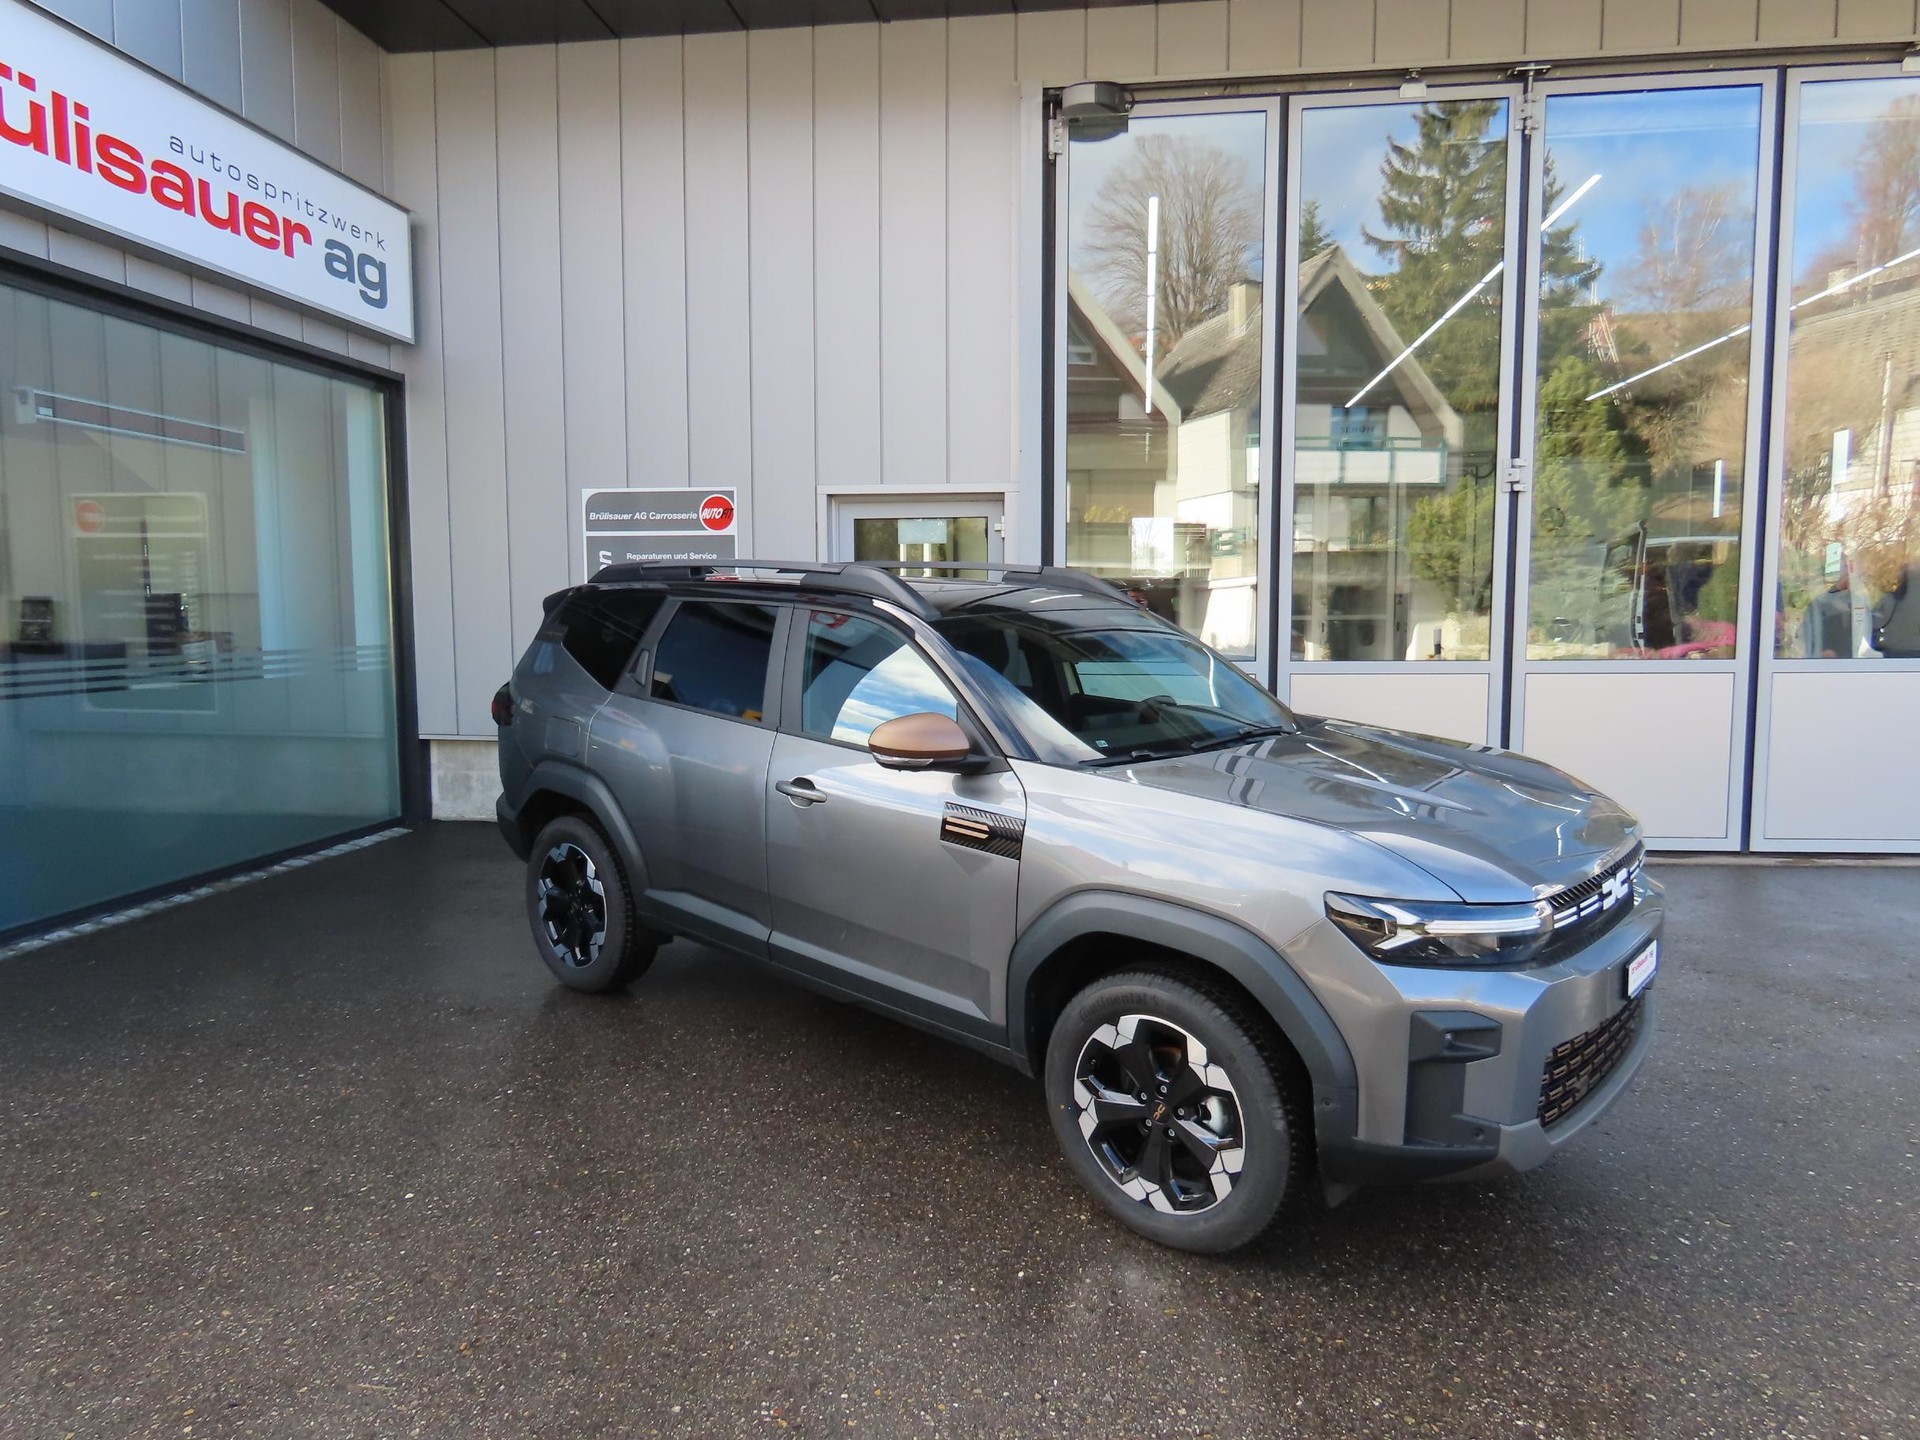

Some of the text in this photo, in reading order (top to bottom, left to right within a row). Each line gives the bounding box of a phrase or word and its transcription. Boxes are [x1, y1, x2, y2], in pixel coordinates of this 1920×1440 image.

[169, 134, 386, 251] autospritzwerk
[324, 238, 388, 309] ag
[589, 511, 698, 521] Brülisauer AG Carrosserie
[626, 552, 718, 561] Reparaturen und Service
